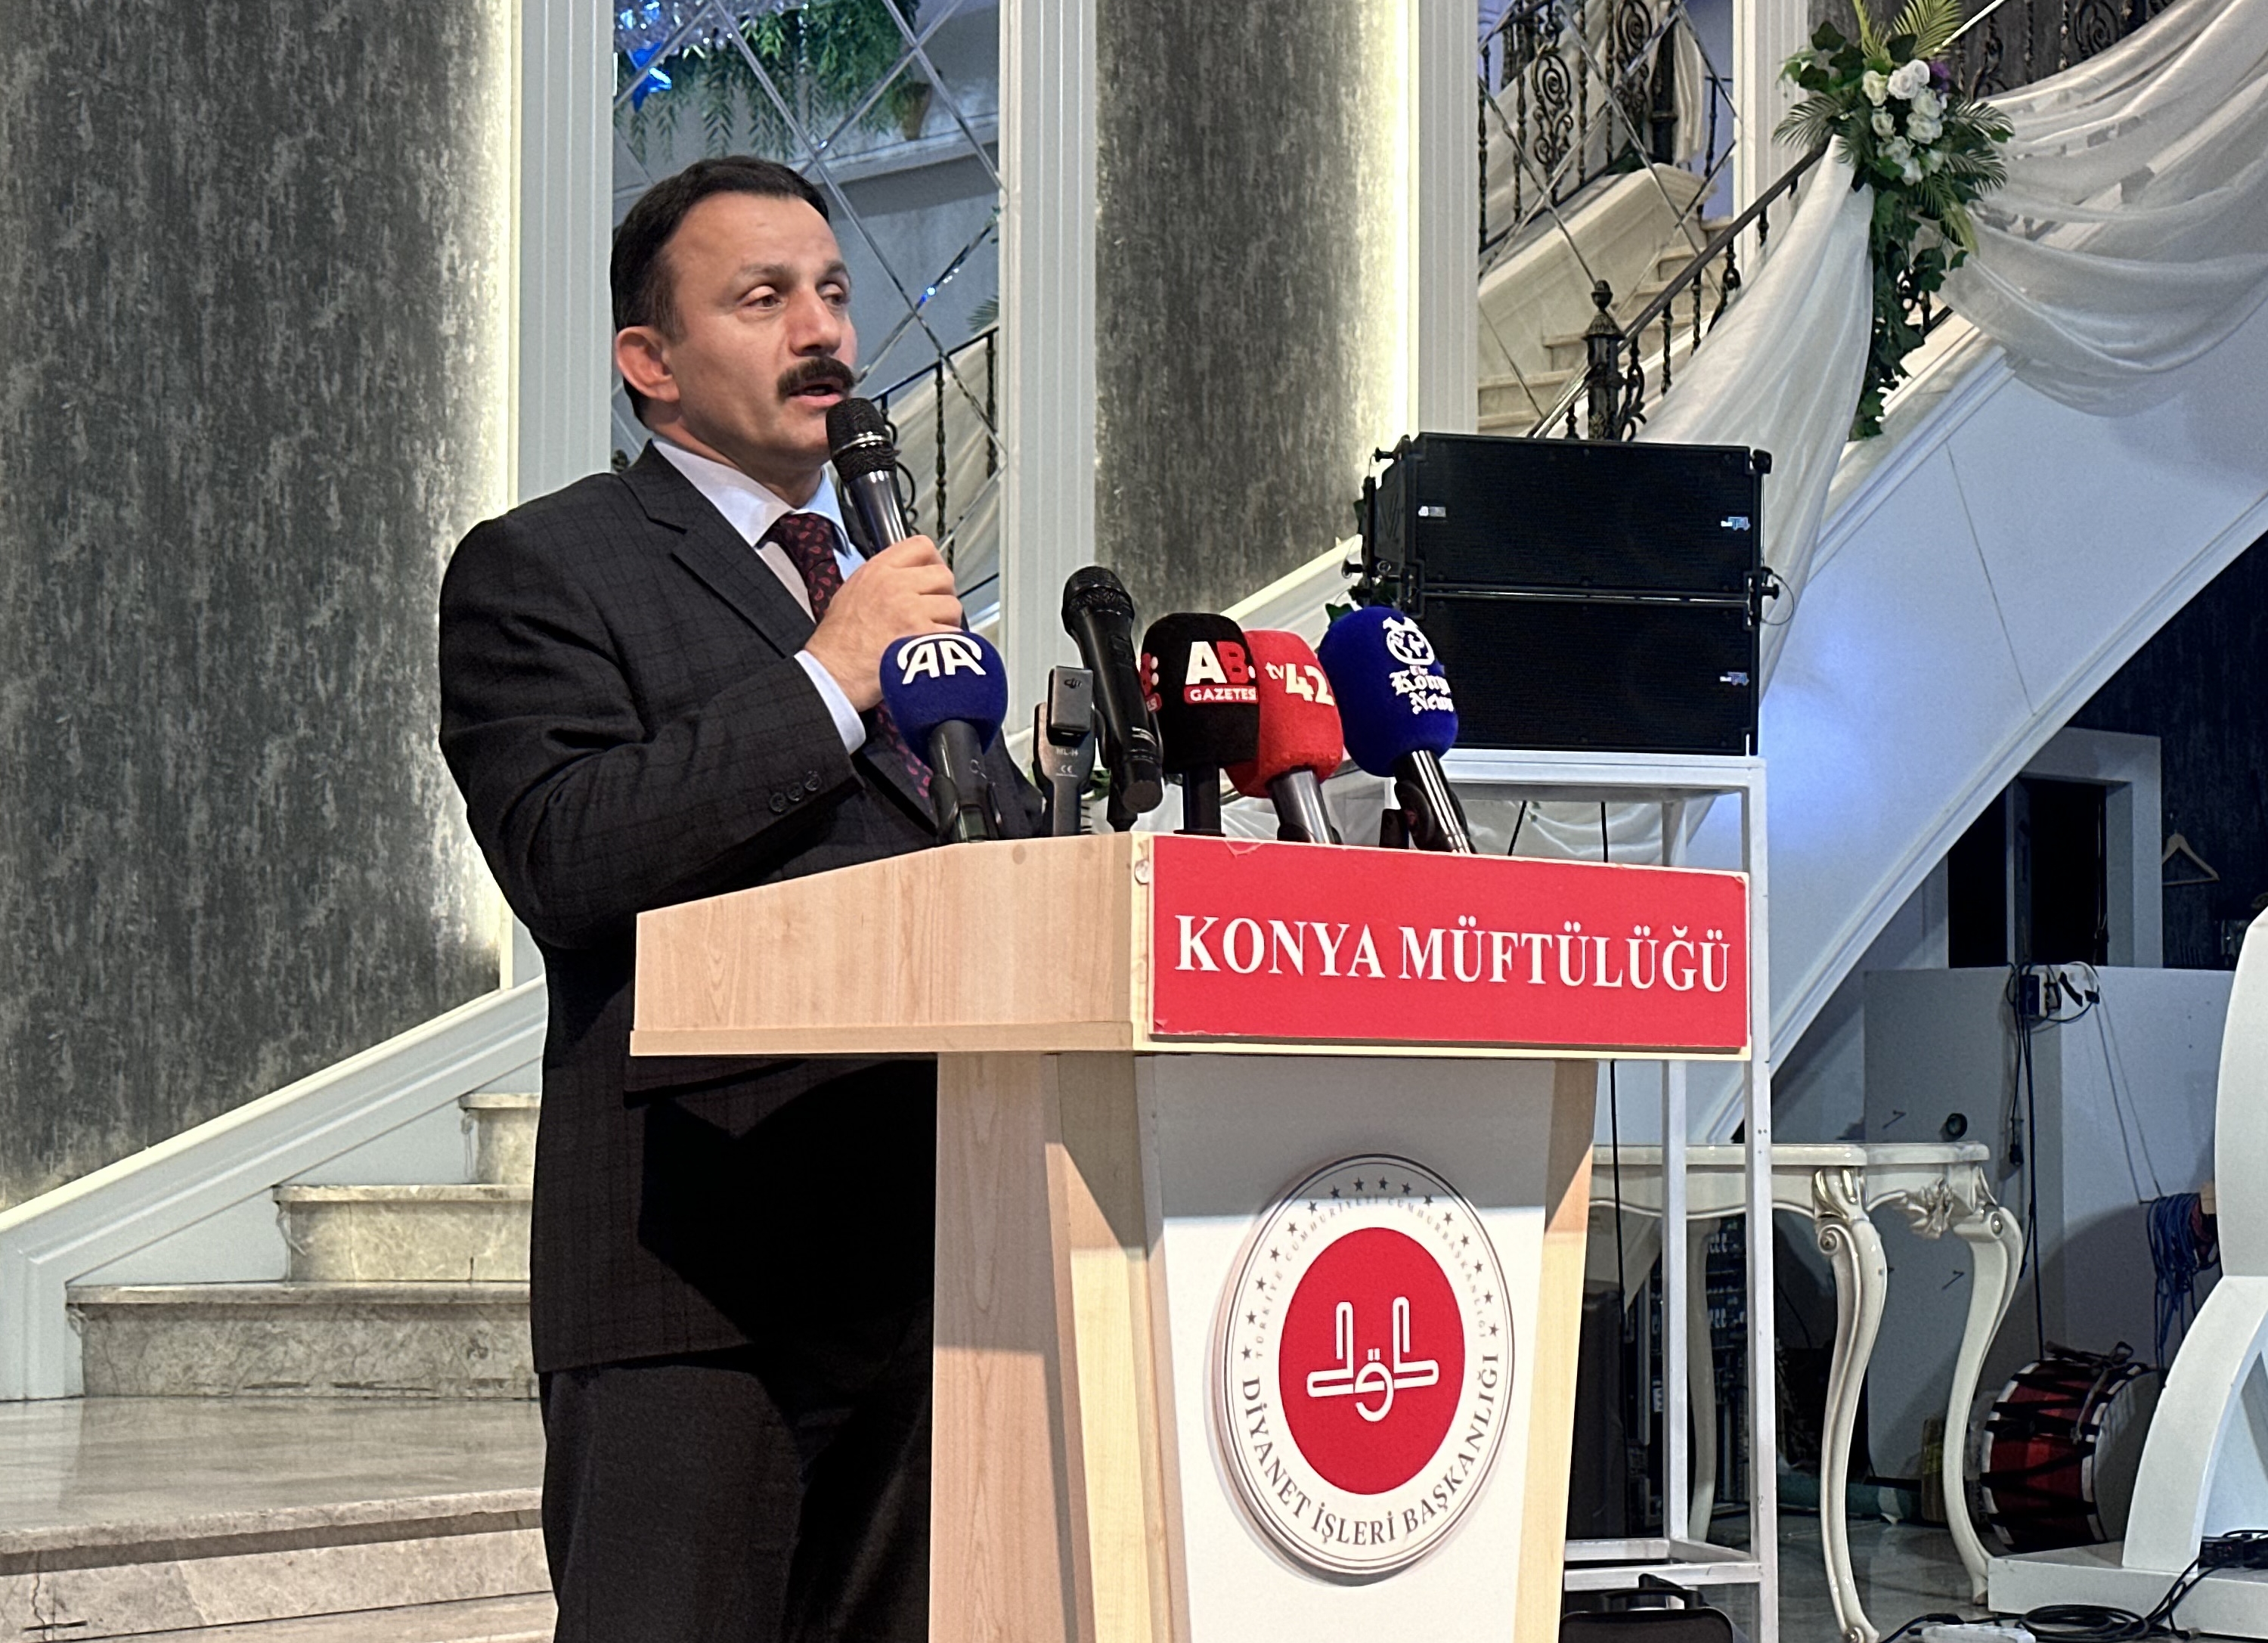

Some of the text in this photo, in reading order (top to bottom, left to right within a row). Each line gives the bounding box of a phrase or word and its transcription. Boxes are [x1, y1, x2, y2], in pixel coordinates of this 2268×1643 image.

[1174, 914, 1731, 993] KONYA MÜFTÜLÜĞÜ
[1242, 1353, 1499, 1546] DİYANET İŞLERİ BAŞKANLIĞI
